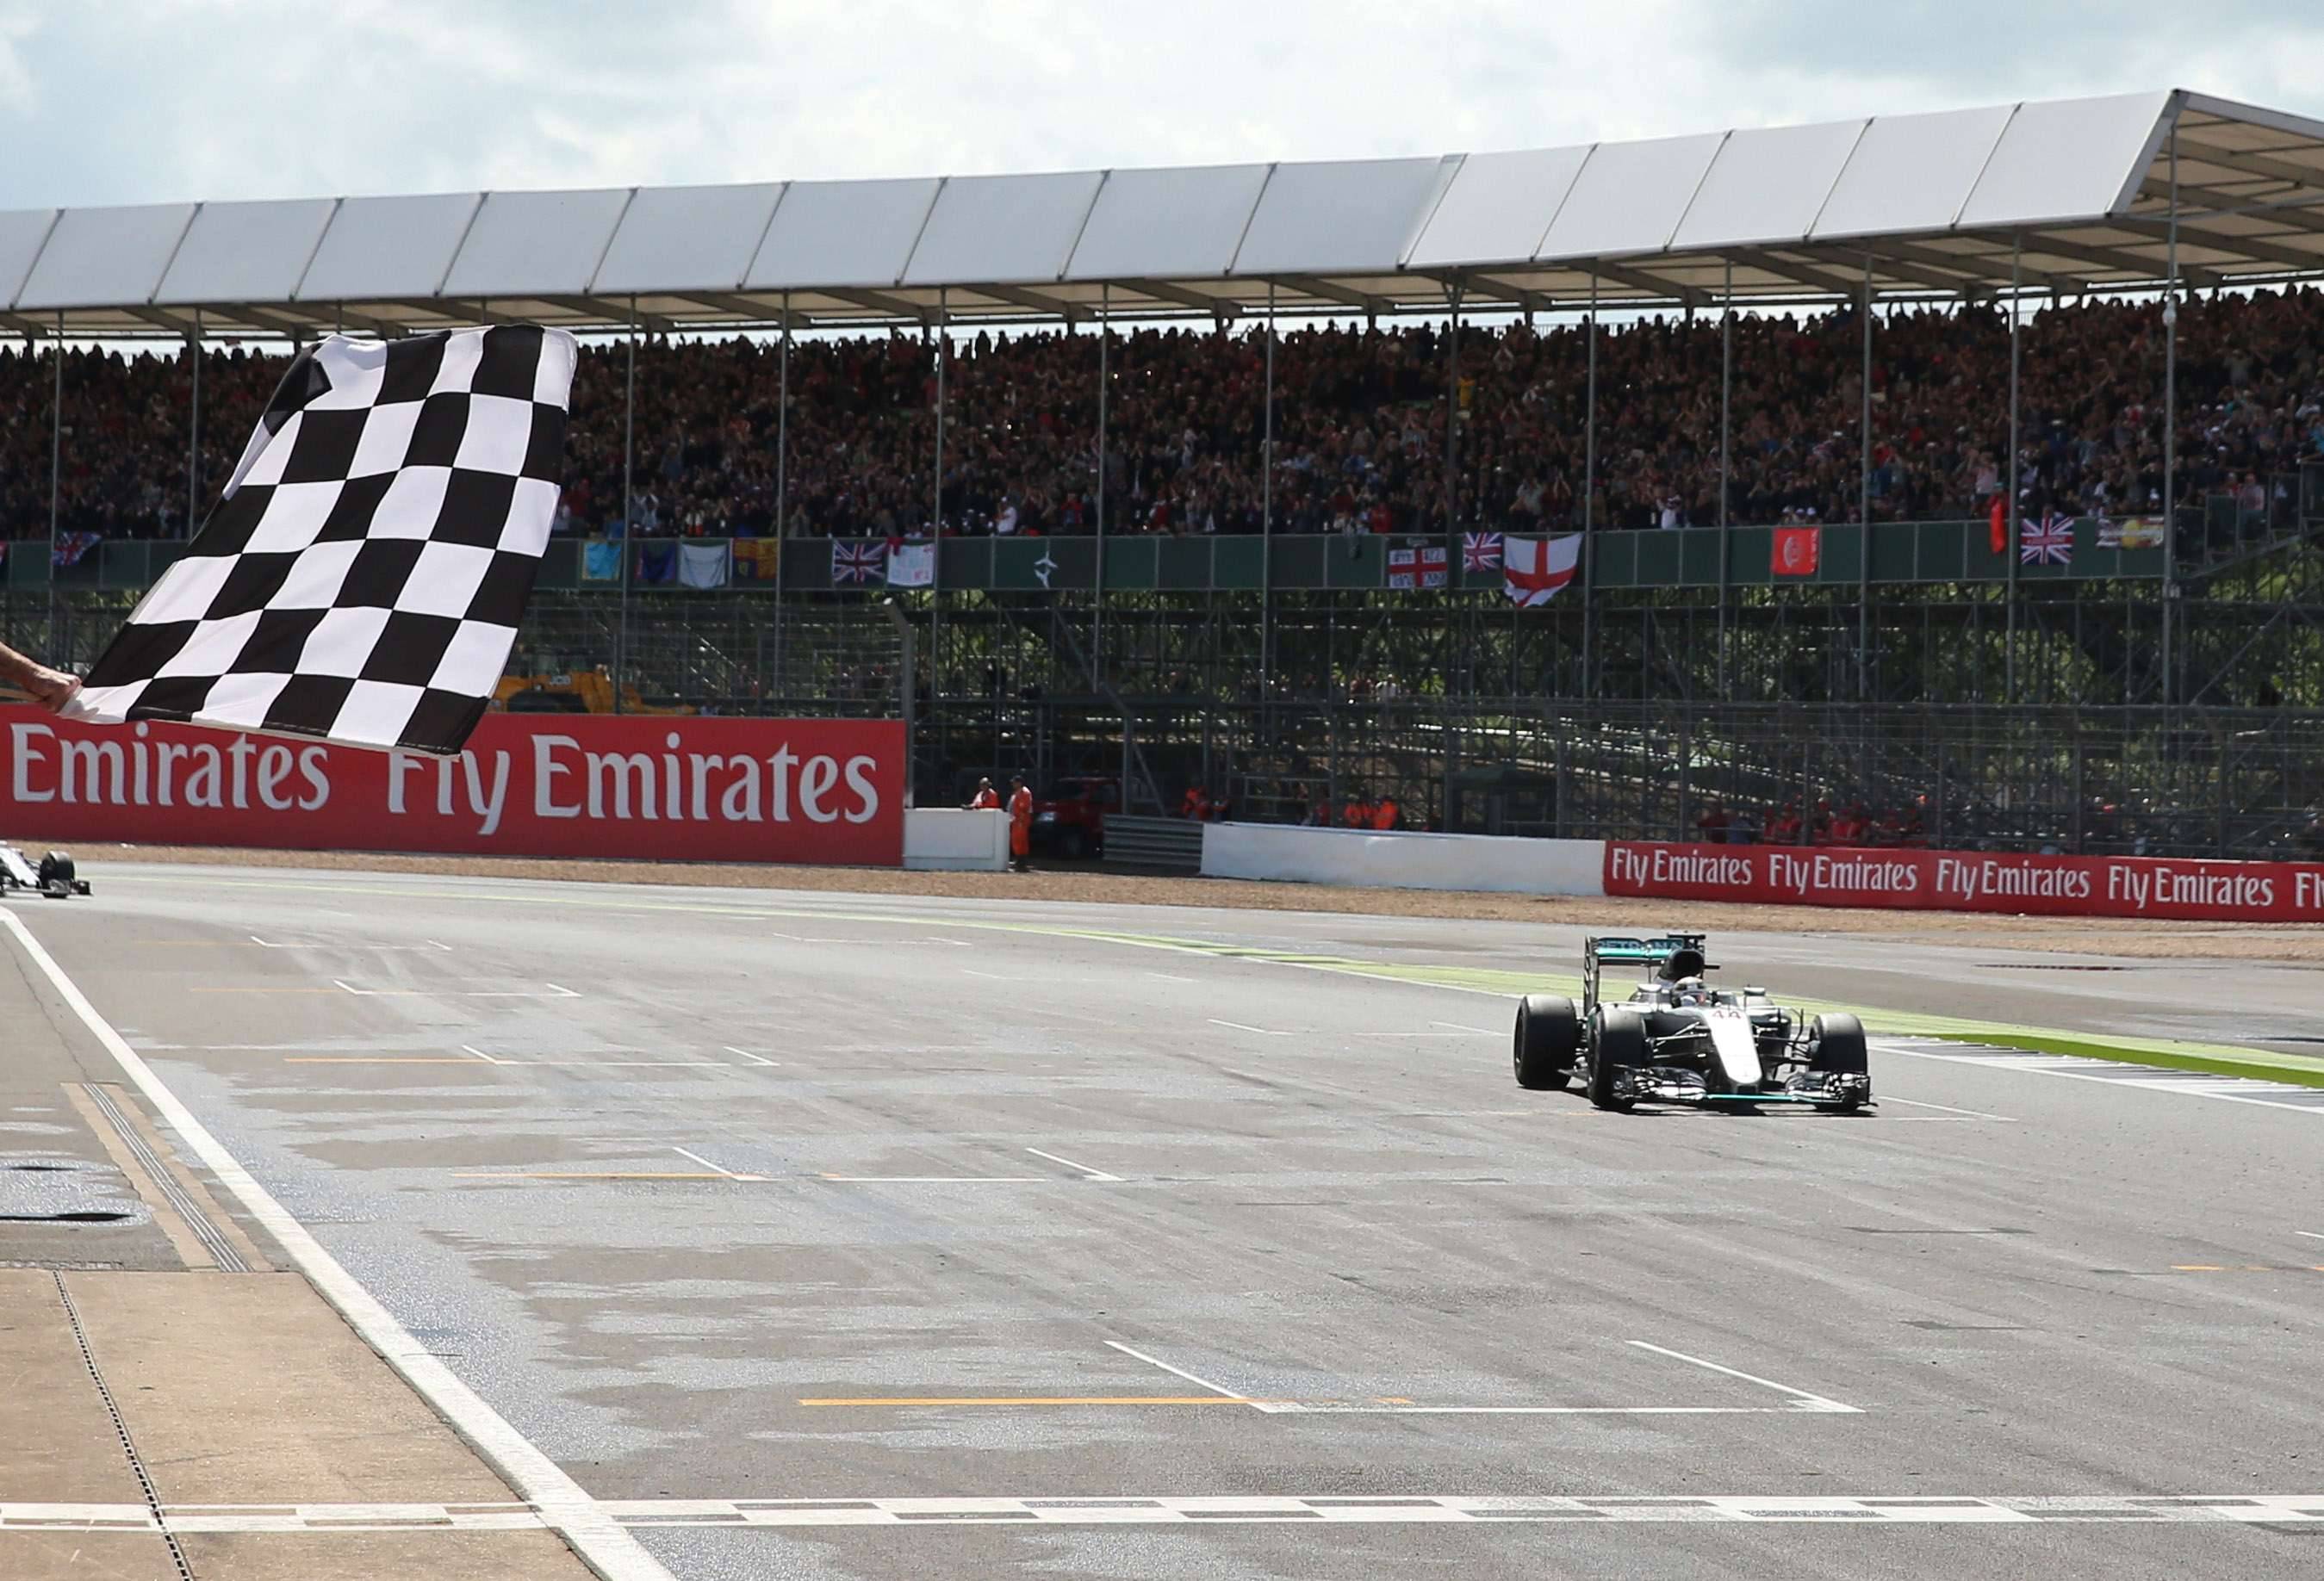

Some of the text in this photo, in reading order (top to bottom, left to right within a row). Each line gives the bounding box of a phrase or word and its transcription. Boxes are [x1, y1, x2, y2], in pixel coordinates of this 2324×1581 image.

[9, 721, 331, 810] Emirates
[388, 731, 879, 835] Fly Emirates
[1612, 848, 1752, 888] Fly Emirates
[1769, 853, 1918, 895] Fly Emirates
[1936, 859, 2091, 901] Fly Emirates
[2108, 865, 2274, 908] Fly Emirates
[2295, 871, 2324, 908] Fl
